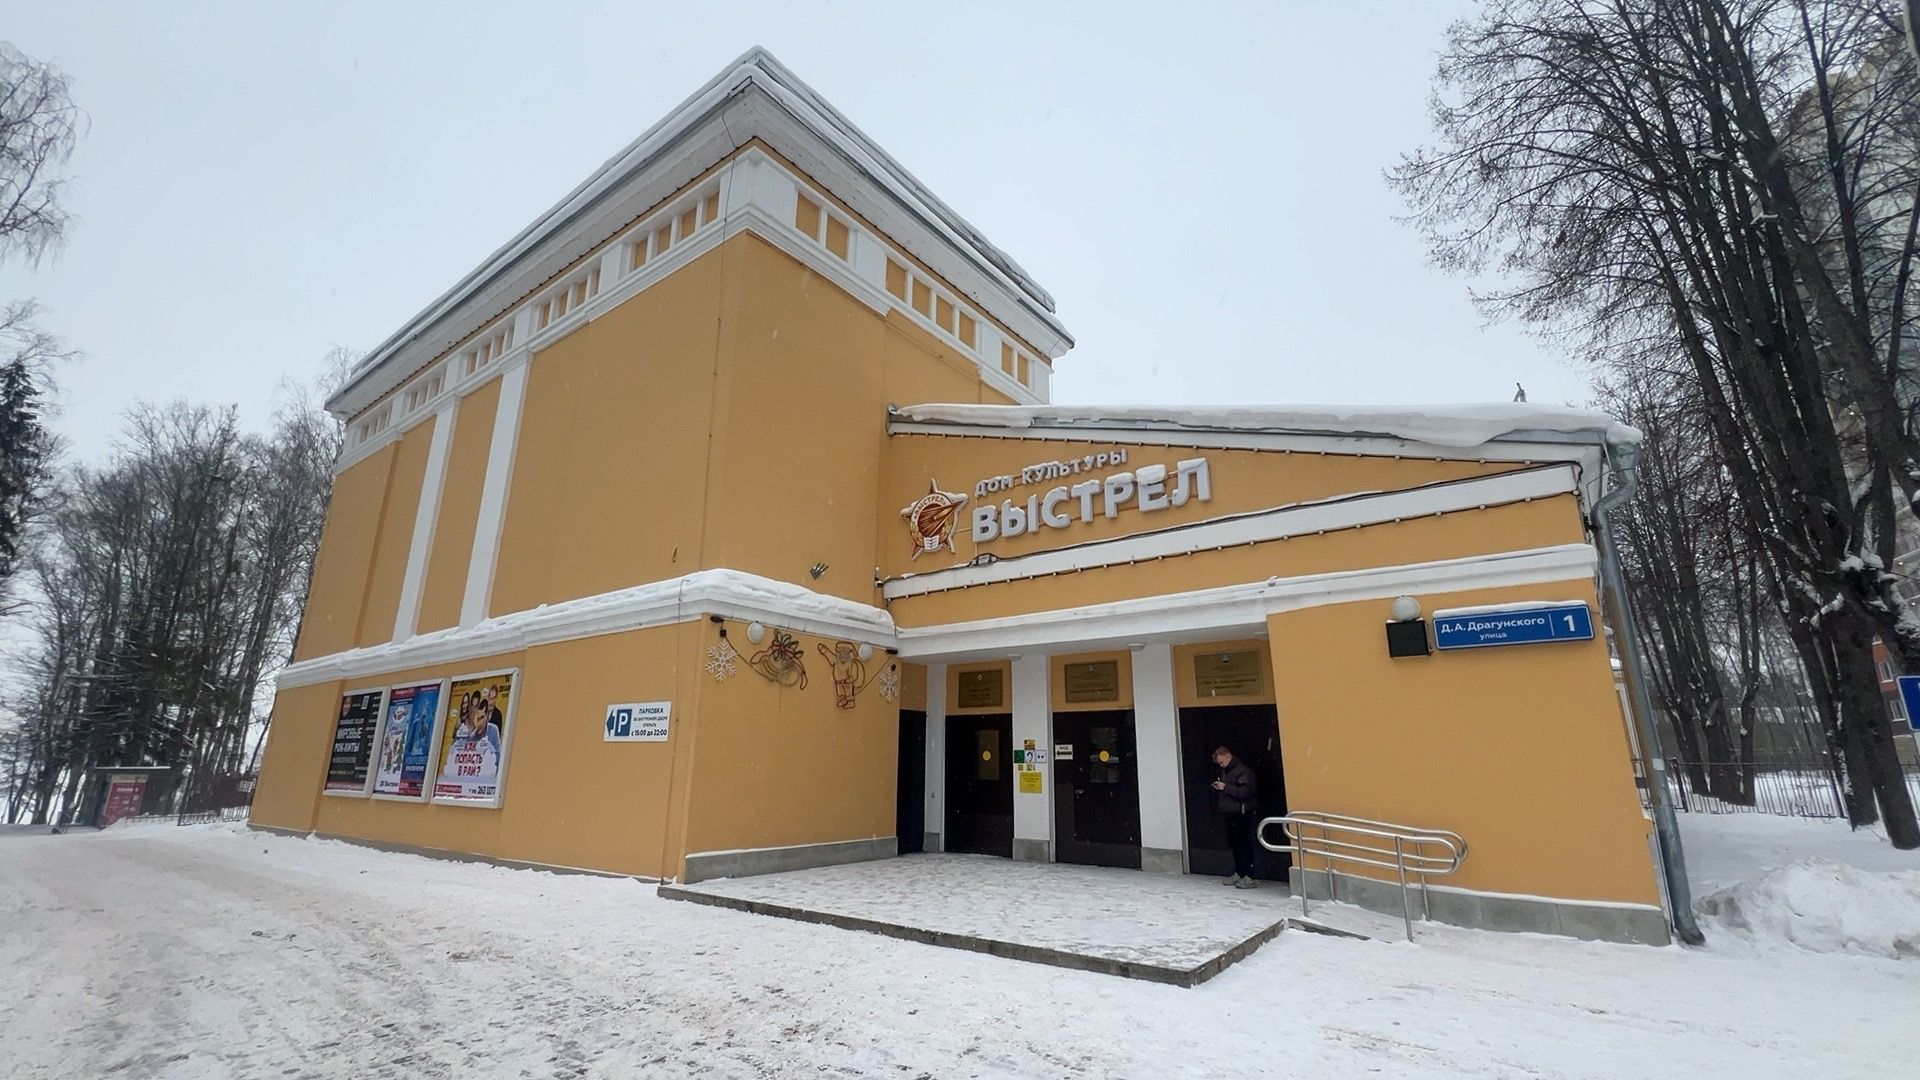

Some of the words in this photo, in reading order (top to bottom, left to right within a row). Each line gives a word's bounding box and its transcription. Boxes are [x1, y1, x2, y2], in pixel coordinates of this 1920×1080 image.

[974, 475, 1014, 497] ДОМ
[1021, 448, 1128, 484] КУЛЬТУРЫ
[972, 457, 1212, 543] ВЫСТРЕЛ
[1467, 617, 1545, 632] Драгунского
[1563, 614, 1576, 632] 1
[1479, 632, 1507, 641] улица
[464, 742, 476, 751] КАК
[455, 754, 483, 764] ПОПАСТЬ
[458, 766, 462, 776] В
